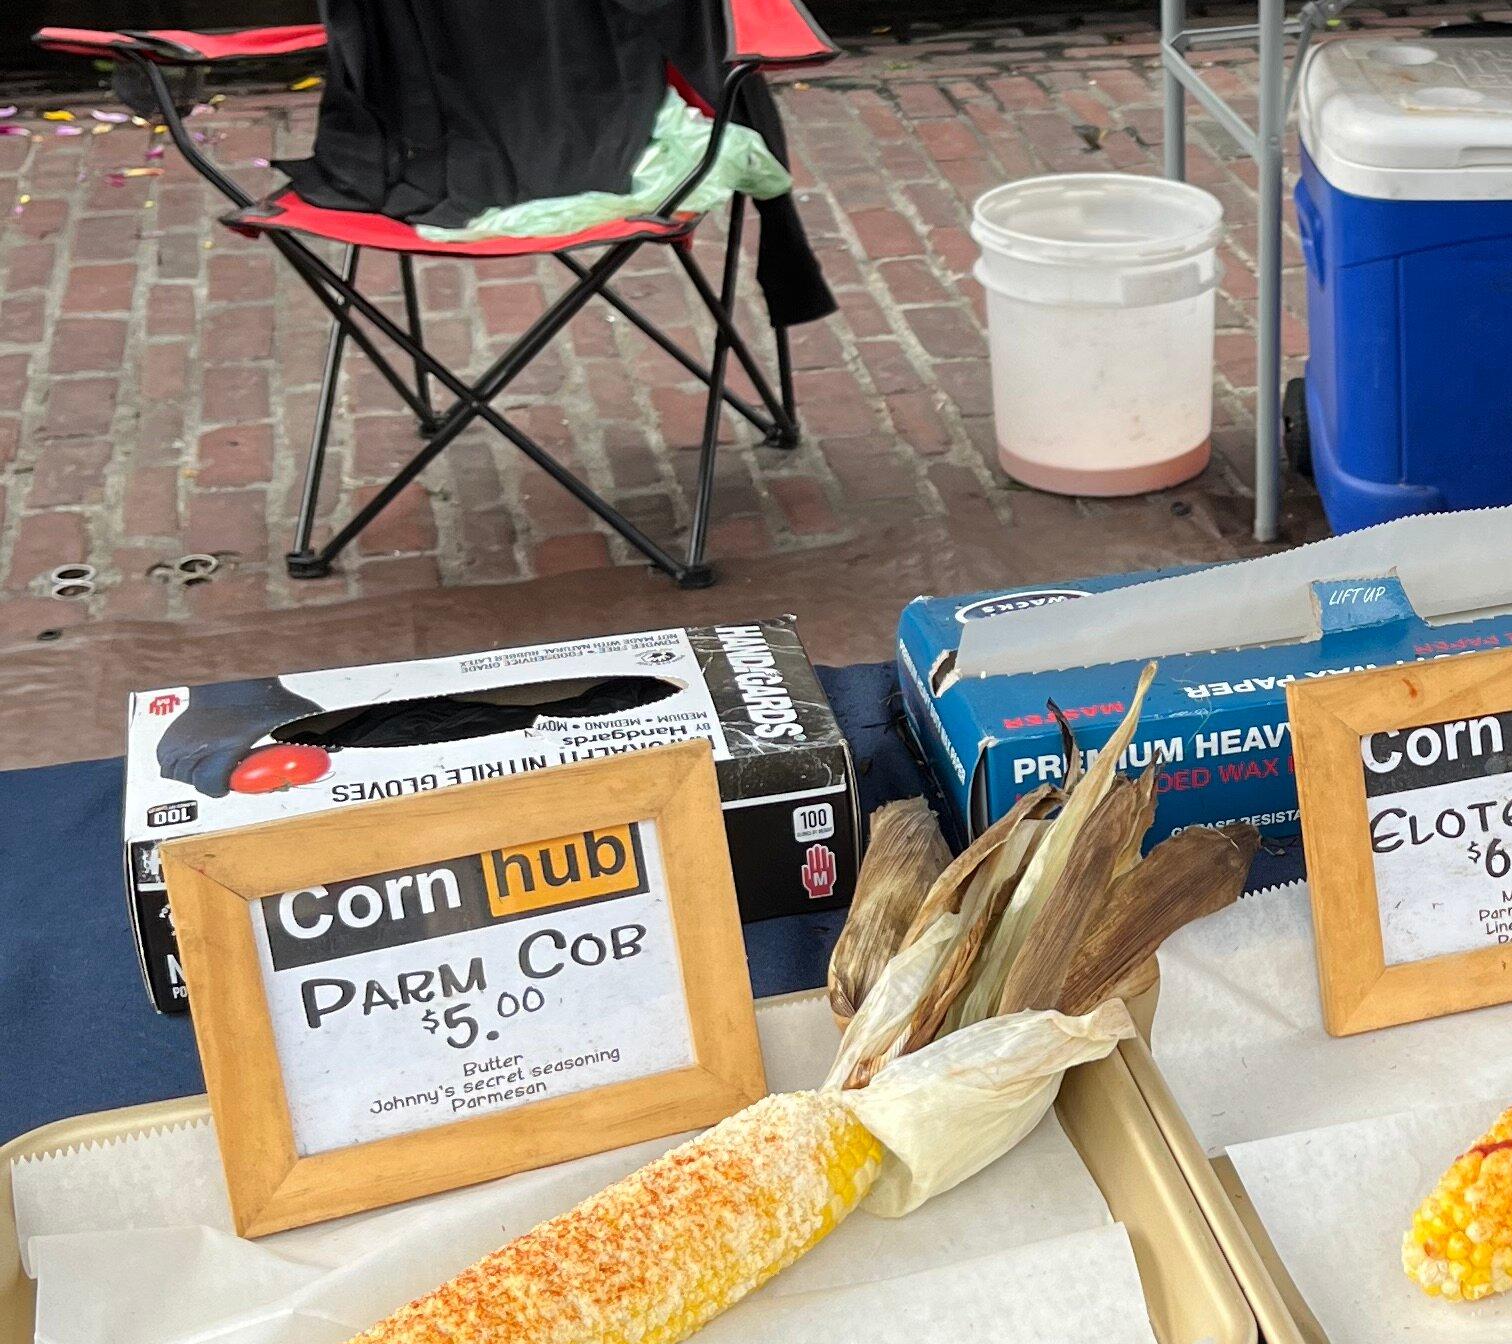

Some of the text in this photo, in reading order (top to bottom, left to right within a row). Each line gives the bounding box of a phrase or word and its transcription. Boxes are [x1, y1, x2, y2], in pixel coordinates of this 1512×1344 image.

[982, 594, 1067, 614] WACKS
[1328, 586, 1386, 606] LIFT UP
[584, 717, 642, 731] MEDIANO
[656, 710, 708, 723] MEDIUM
[561, 722, 711, 747] BY Handgards
[1361, 716, 1504, 773] Corn
[331, 774, 438, 802] GLOVES
[154, 808, 191, 825] 100
[800, 808, 827, 830] 100
[278, 829, 627, 940] Corn hub
[814, 871, 826, 887] M
[301, 924, 647, 1029] PARM COB
[463, 1052, 524, 1077] Butter
[370, 1047, 621, 1114] Johnny's secret seasoning
[451, 1080, 547, 1112] Parmesan
